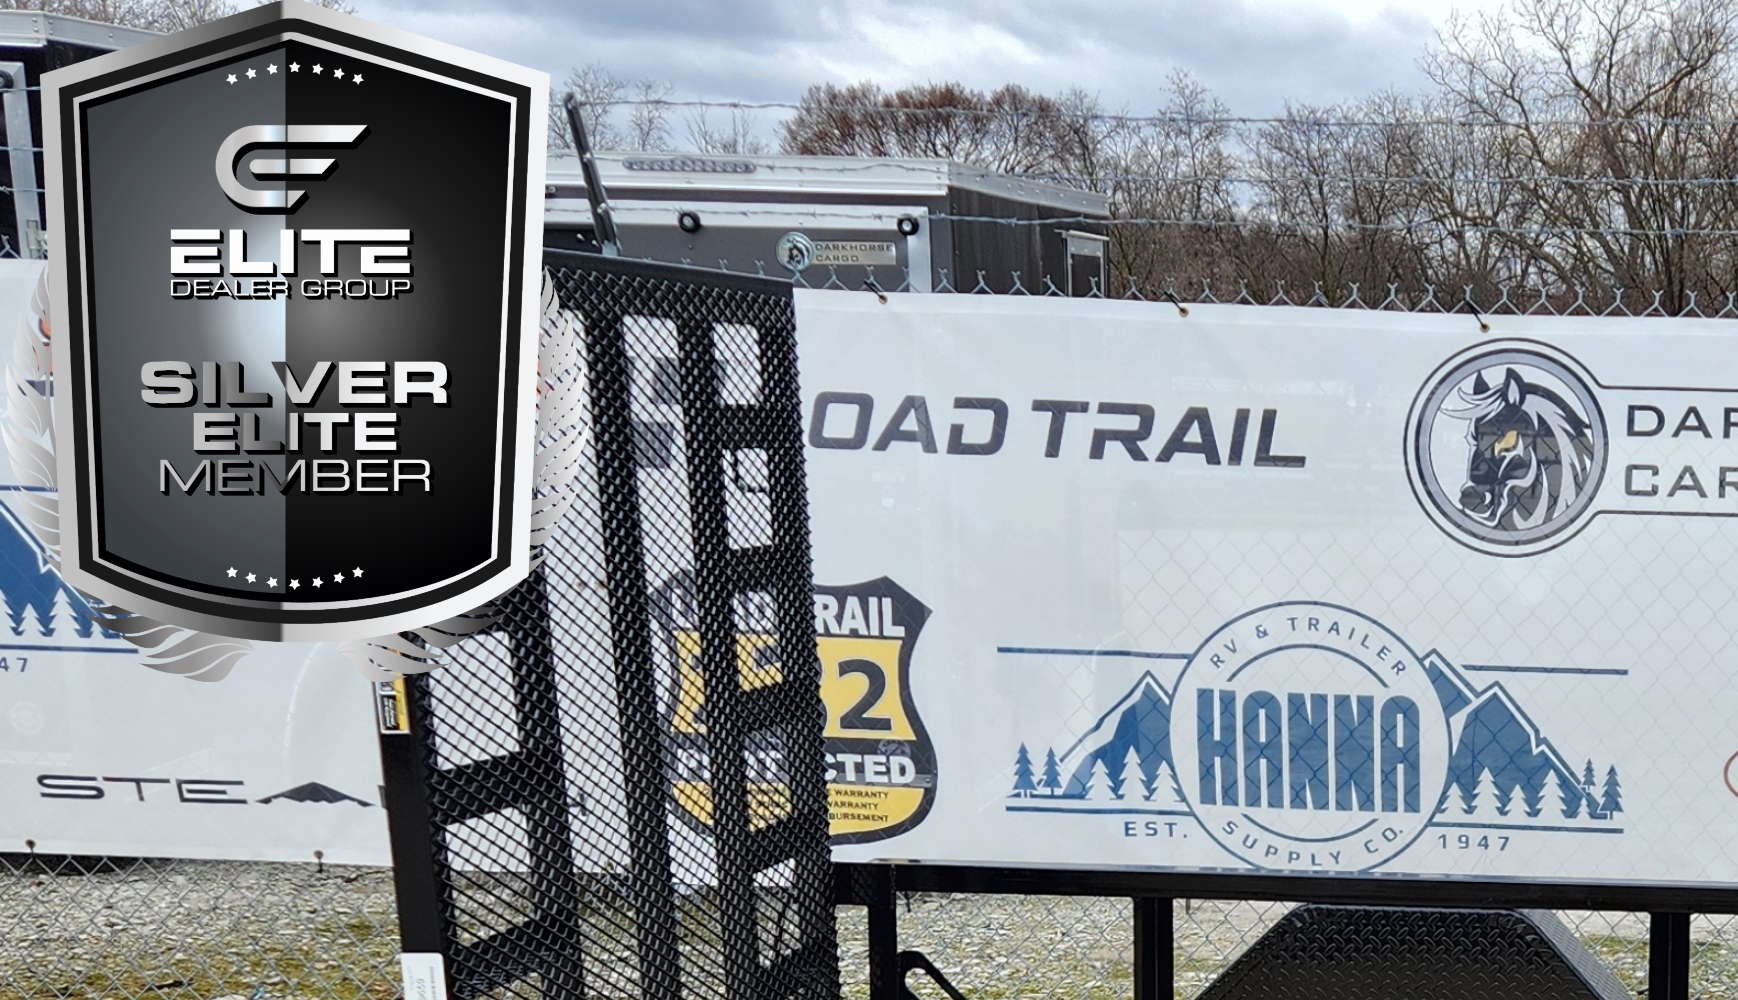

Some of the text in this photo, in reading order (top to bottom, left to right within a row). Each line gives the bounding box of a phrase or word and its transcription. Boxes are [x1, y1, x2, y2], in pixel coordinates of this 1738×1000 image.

[814, 243, 894, 253] DARKHORSE
[815, 254, 860, 263] CARGO
[808, 391, 1307, 469] OAD TRAIL
[815, 594, 906, 638] RAIL
[1209, 616, 1407, 677] RV & TRAILER
[0, 656, 29, 673] 47
[1196, 688, 1421, 813] HANNA
[834, 789, 890, 800] WARRANTY
[828, 812, 890, 823] BURSEMENT
[1123, 820, 1189, 839] EST.
[1221, 820, 1405, 867] SUPPLY CO.
[1438, 833, 1512, 852] 1947
